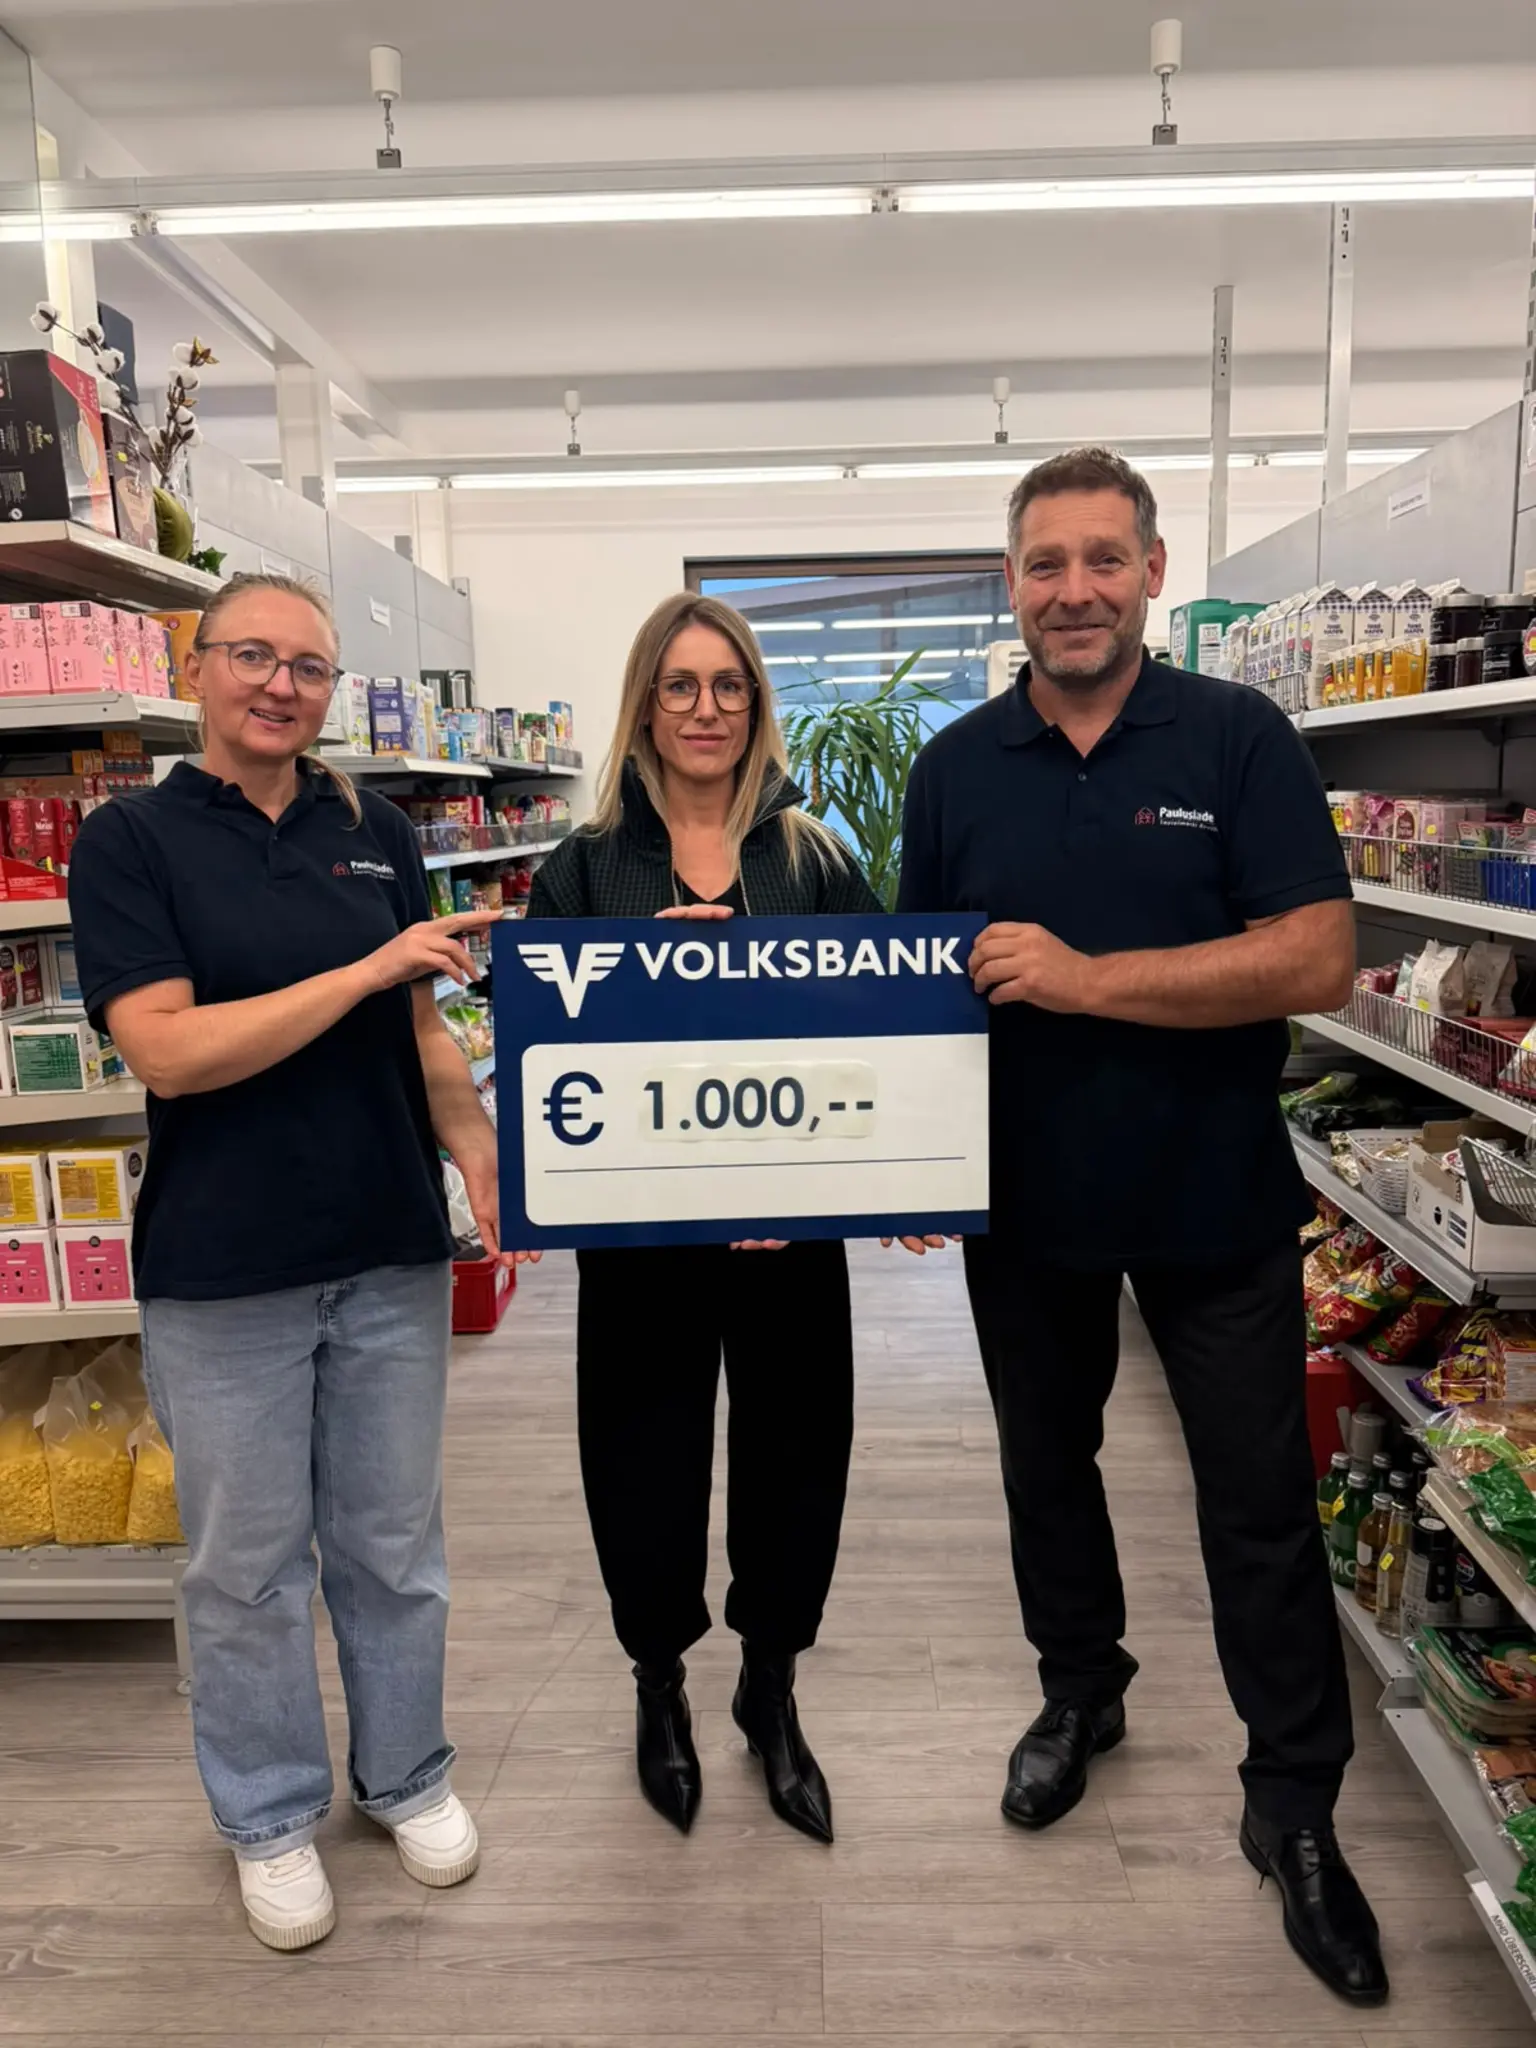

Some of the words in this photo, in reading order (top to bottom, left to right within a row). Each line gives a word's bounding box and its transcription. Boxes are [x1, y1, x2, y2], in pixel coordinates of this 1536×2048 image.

[634, 937, 964, 980] VOLKSBANK
[543, 1071, 604, 1145] €
[643, 1077, 874, 1133] 1.000,--
[1491, 1914, 1509, 1937] MHD
